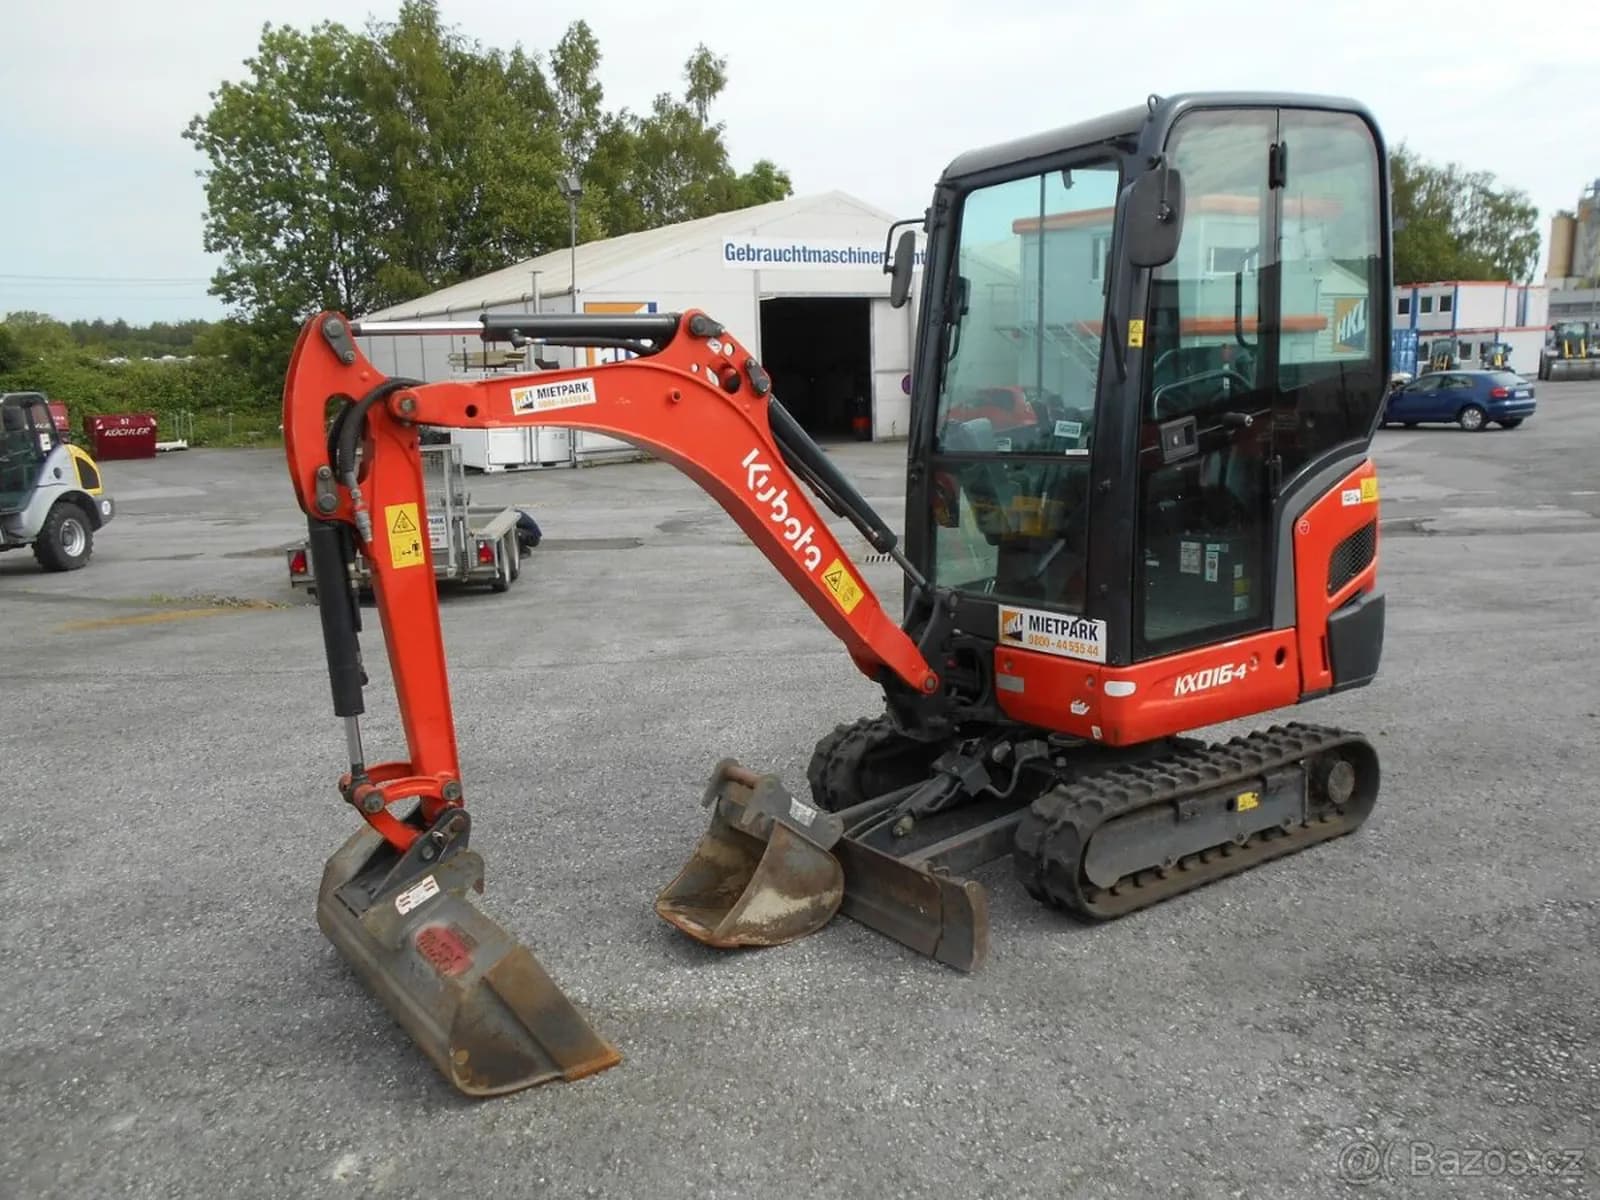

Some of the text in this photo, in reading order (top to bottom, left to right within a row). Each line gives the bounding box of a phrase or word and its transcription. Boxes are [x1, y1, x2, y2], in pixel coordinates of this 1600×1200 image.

[536, 381, 590, 400] MIETPARK
[741, 447, 822, 572] Kubota
[1028, 614, 1098, 641] MIETPARK
